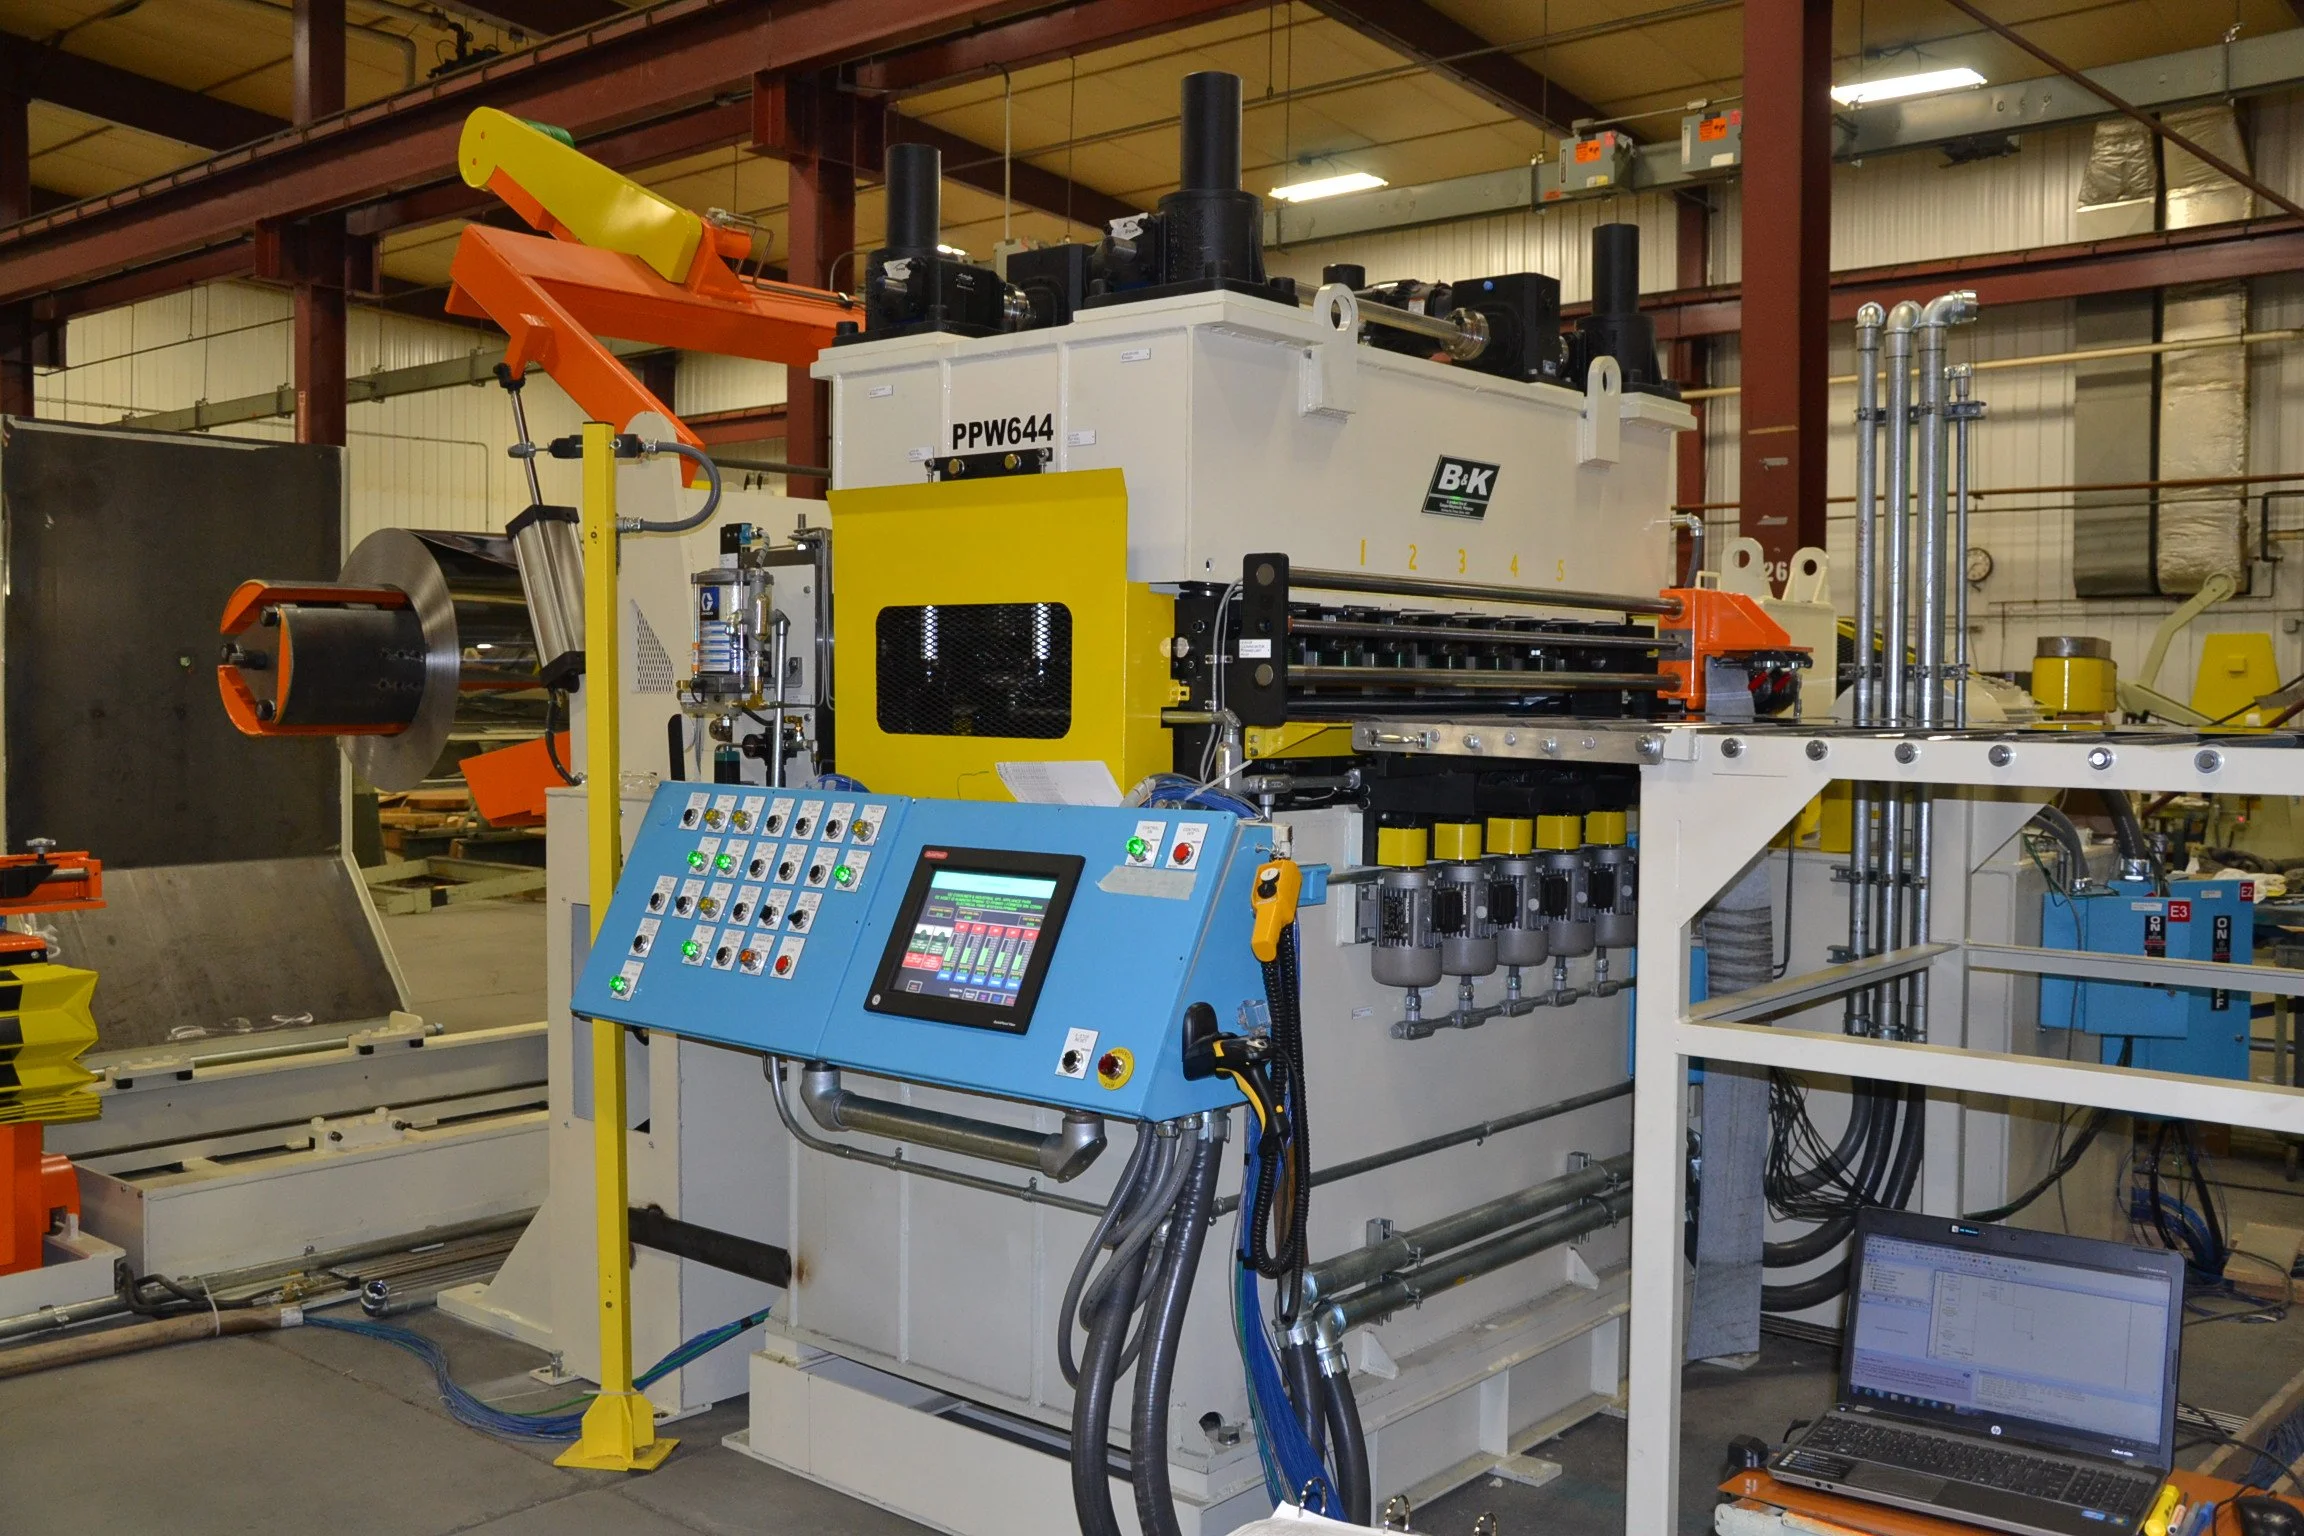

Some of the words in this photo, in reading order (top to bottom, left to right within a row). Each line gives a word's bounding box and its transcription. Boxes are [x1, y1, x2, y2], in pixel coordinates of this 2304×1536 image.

[952, 413, 1054, 450] PPW644
[1437, 463, 1495, 496] B&K
[1408, 543, 1418, 571] 2
[1458, 548, 1467, 574] 3
[1509, 553, 1519, 577] 4
[1555, 558, 1565, 582] 5
[1764, 561, 1788, 582] 26
[2241, 886, 2253, 898] E2
[2170, 905, 2188, 918] E3
[2150, 915, 2161, 932] ON
[2216, 917, 2228, 940] ON
